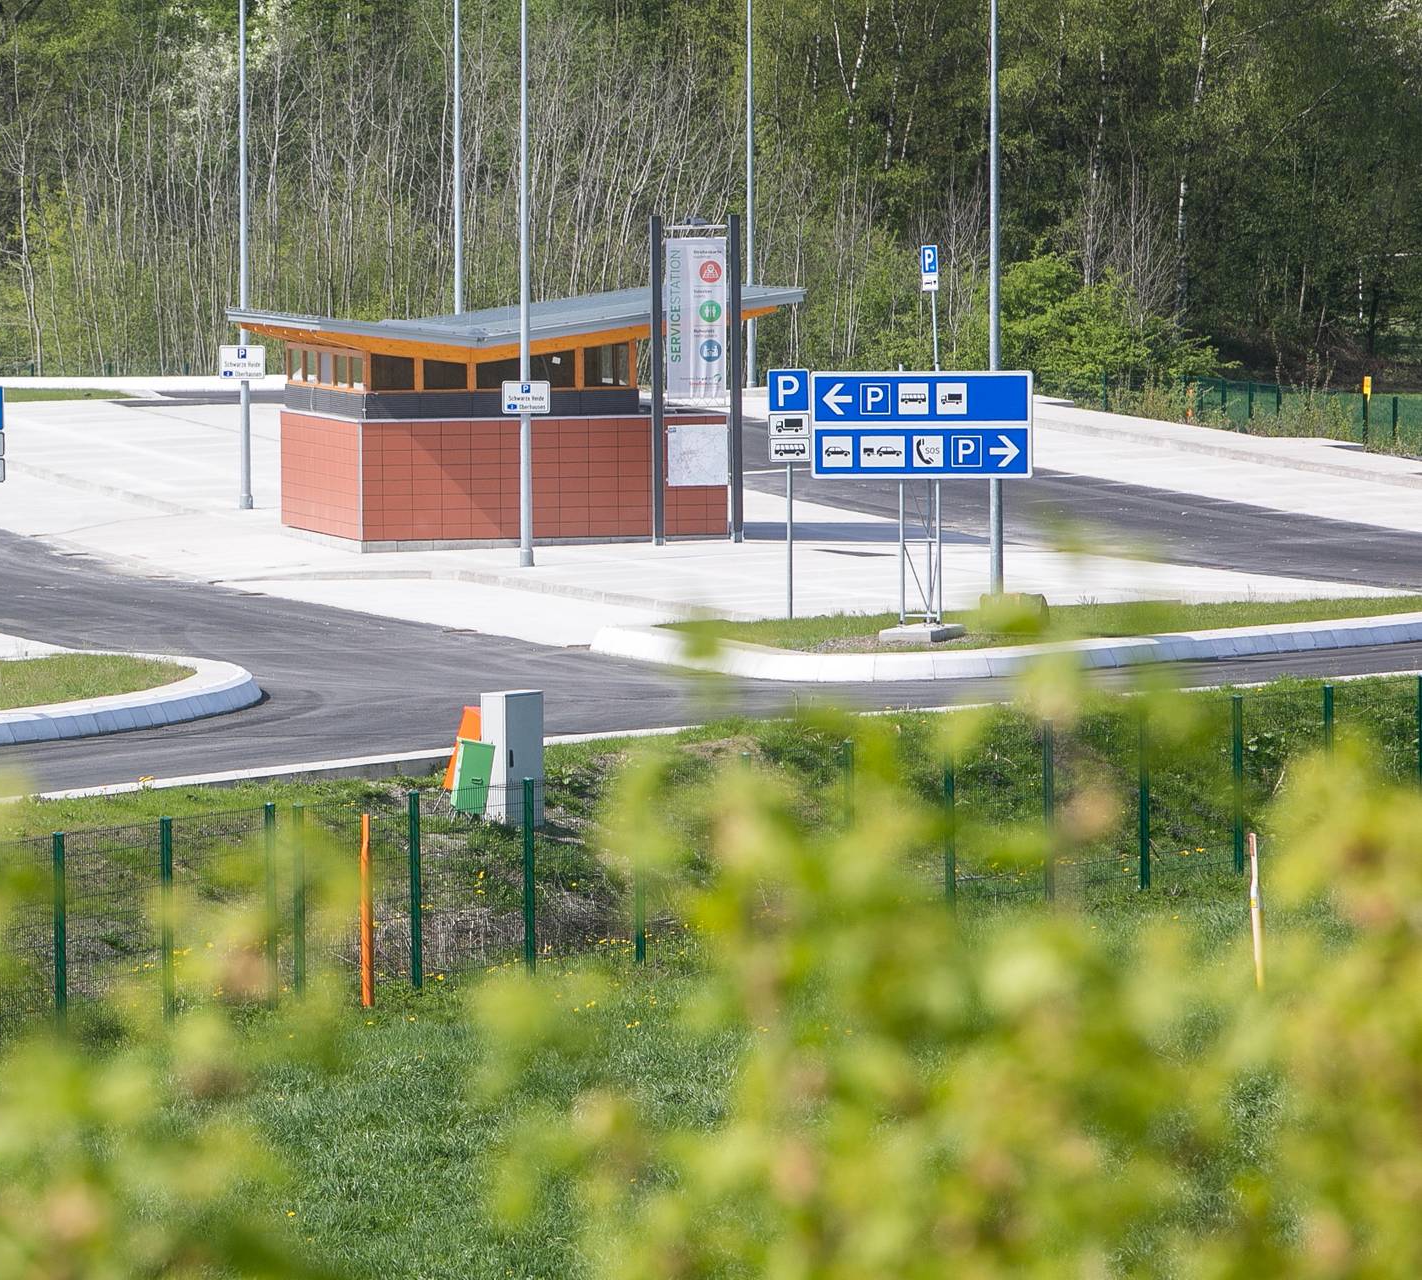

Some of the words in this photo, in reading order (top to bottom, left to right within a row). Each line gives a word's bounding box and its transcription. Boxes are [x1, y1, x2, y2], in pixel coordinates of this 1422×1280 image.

[925, 249, 934, 271] P
[778, 375, 799, 407] P
[867, 387, 884, 411] P
[925, 446, 940, 455] SOS
[958, 439, 975, 463] P
